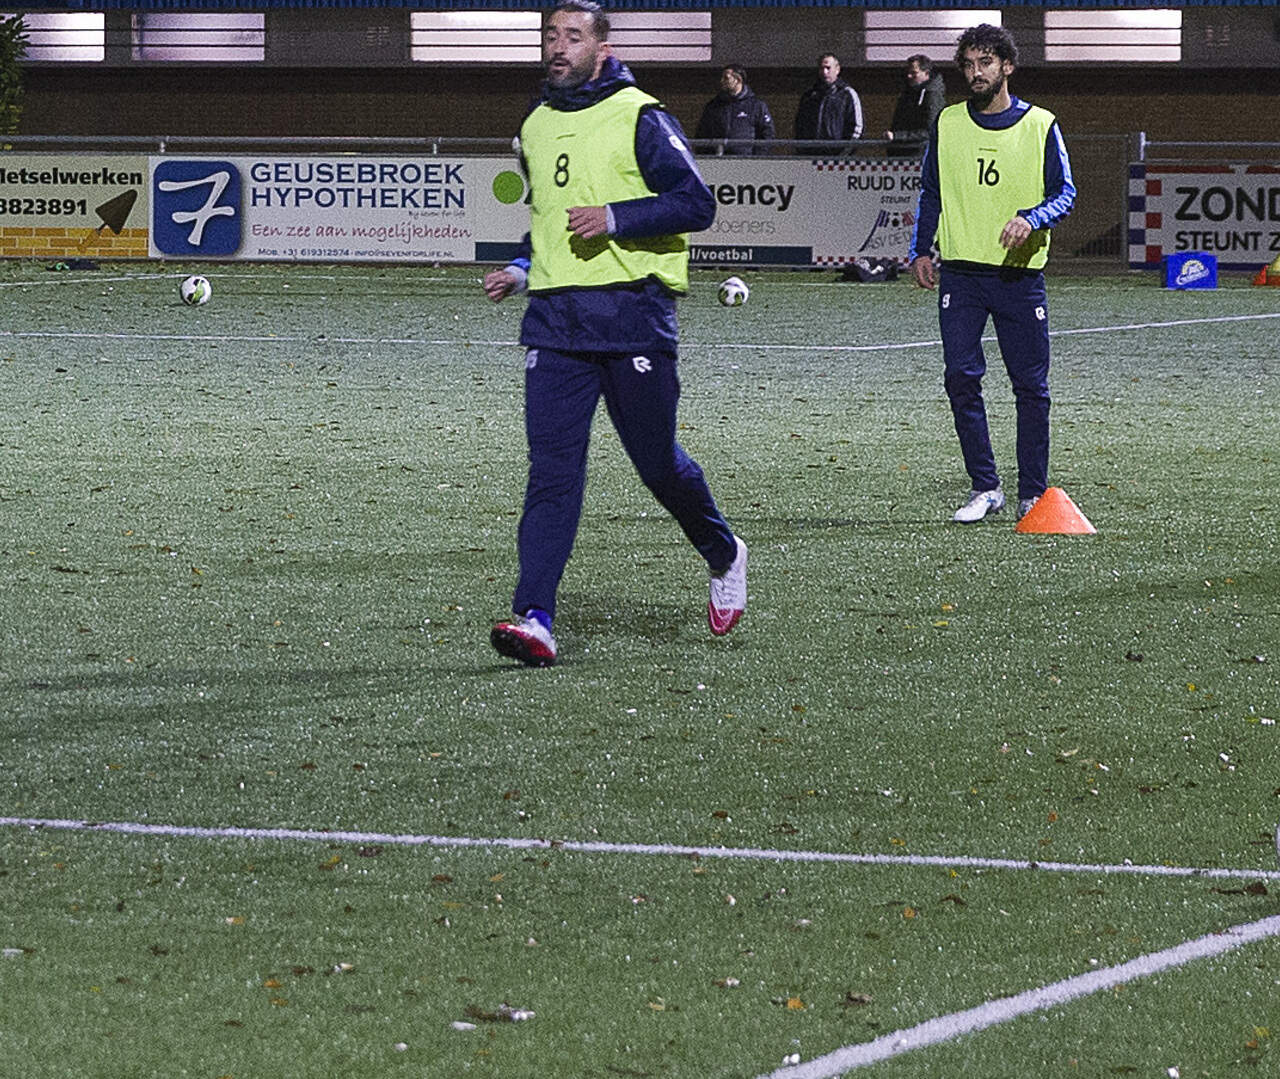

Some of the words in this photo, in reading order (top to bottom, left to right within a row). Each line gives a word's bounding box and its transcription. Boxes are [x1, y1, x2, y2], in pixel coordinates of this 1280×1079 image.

[250, 162, 465, 184] GEUSEBROEK
[553, 152, 570, 188] 8
[977, 158, 1000, 187] 16
[847, 176, 896, 191] RUUD
[250, 186, 466, 209] HYPOTHEKEN
[707, 182, 795, 212] ency
[252, 223, 282, 237] Een
[286, 224, 311, 237] zee
[315, 225, 347, 238] aan
[351, 221, 472, 245] mogelijkheden
[1174, 231, 1263, 252] STEUNT
[689, 247, 753, 261] l/voetbal
